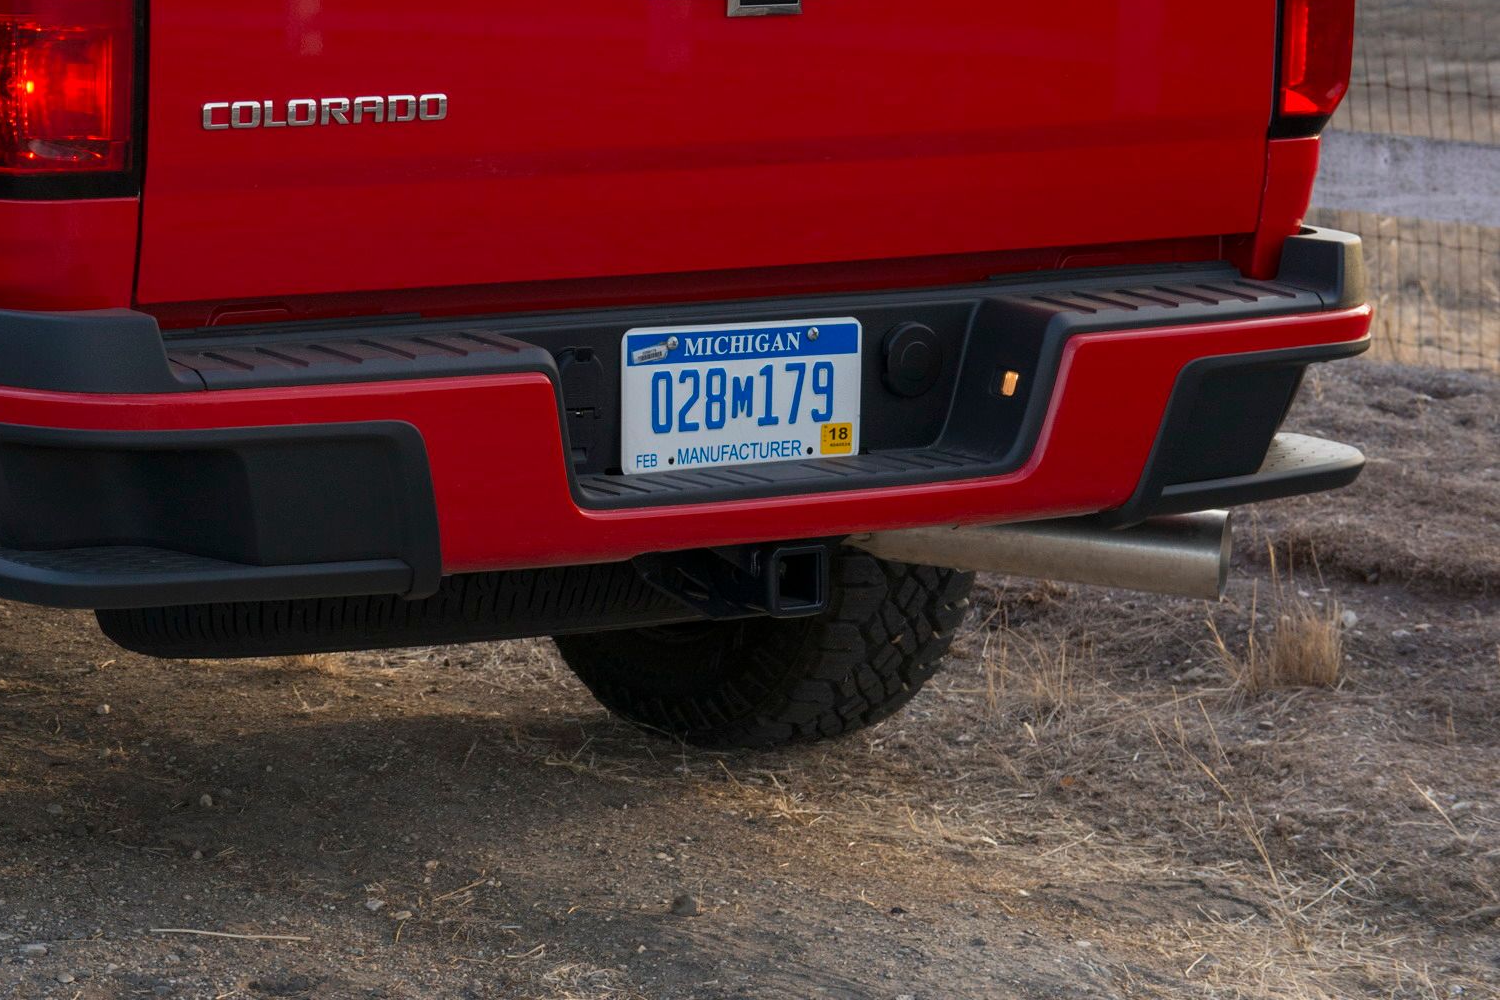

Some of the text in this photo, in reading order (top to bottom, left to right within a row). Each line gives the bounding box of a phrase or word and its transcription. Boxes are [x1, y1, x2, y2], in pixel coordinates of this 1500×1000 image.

[202, 93, 448, 130] COLORADO
[683, 331, 801, 357] MICHIGAN
[651, 361, 834, 434] 028M179
[828, 426, 849, 441] 18
[636, 439, 802, 469] FEB MANUFACTURER
